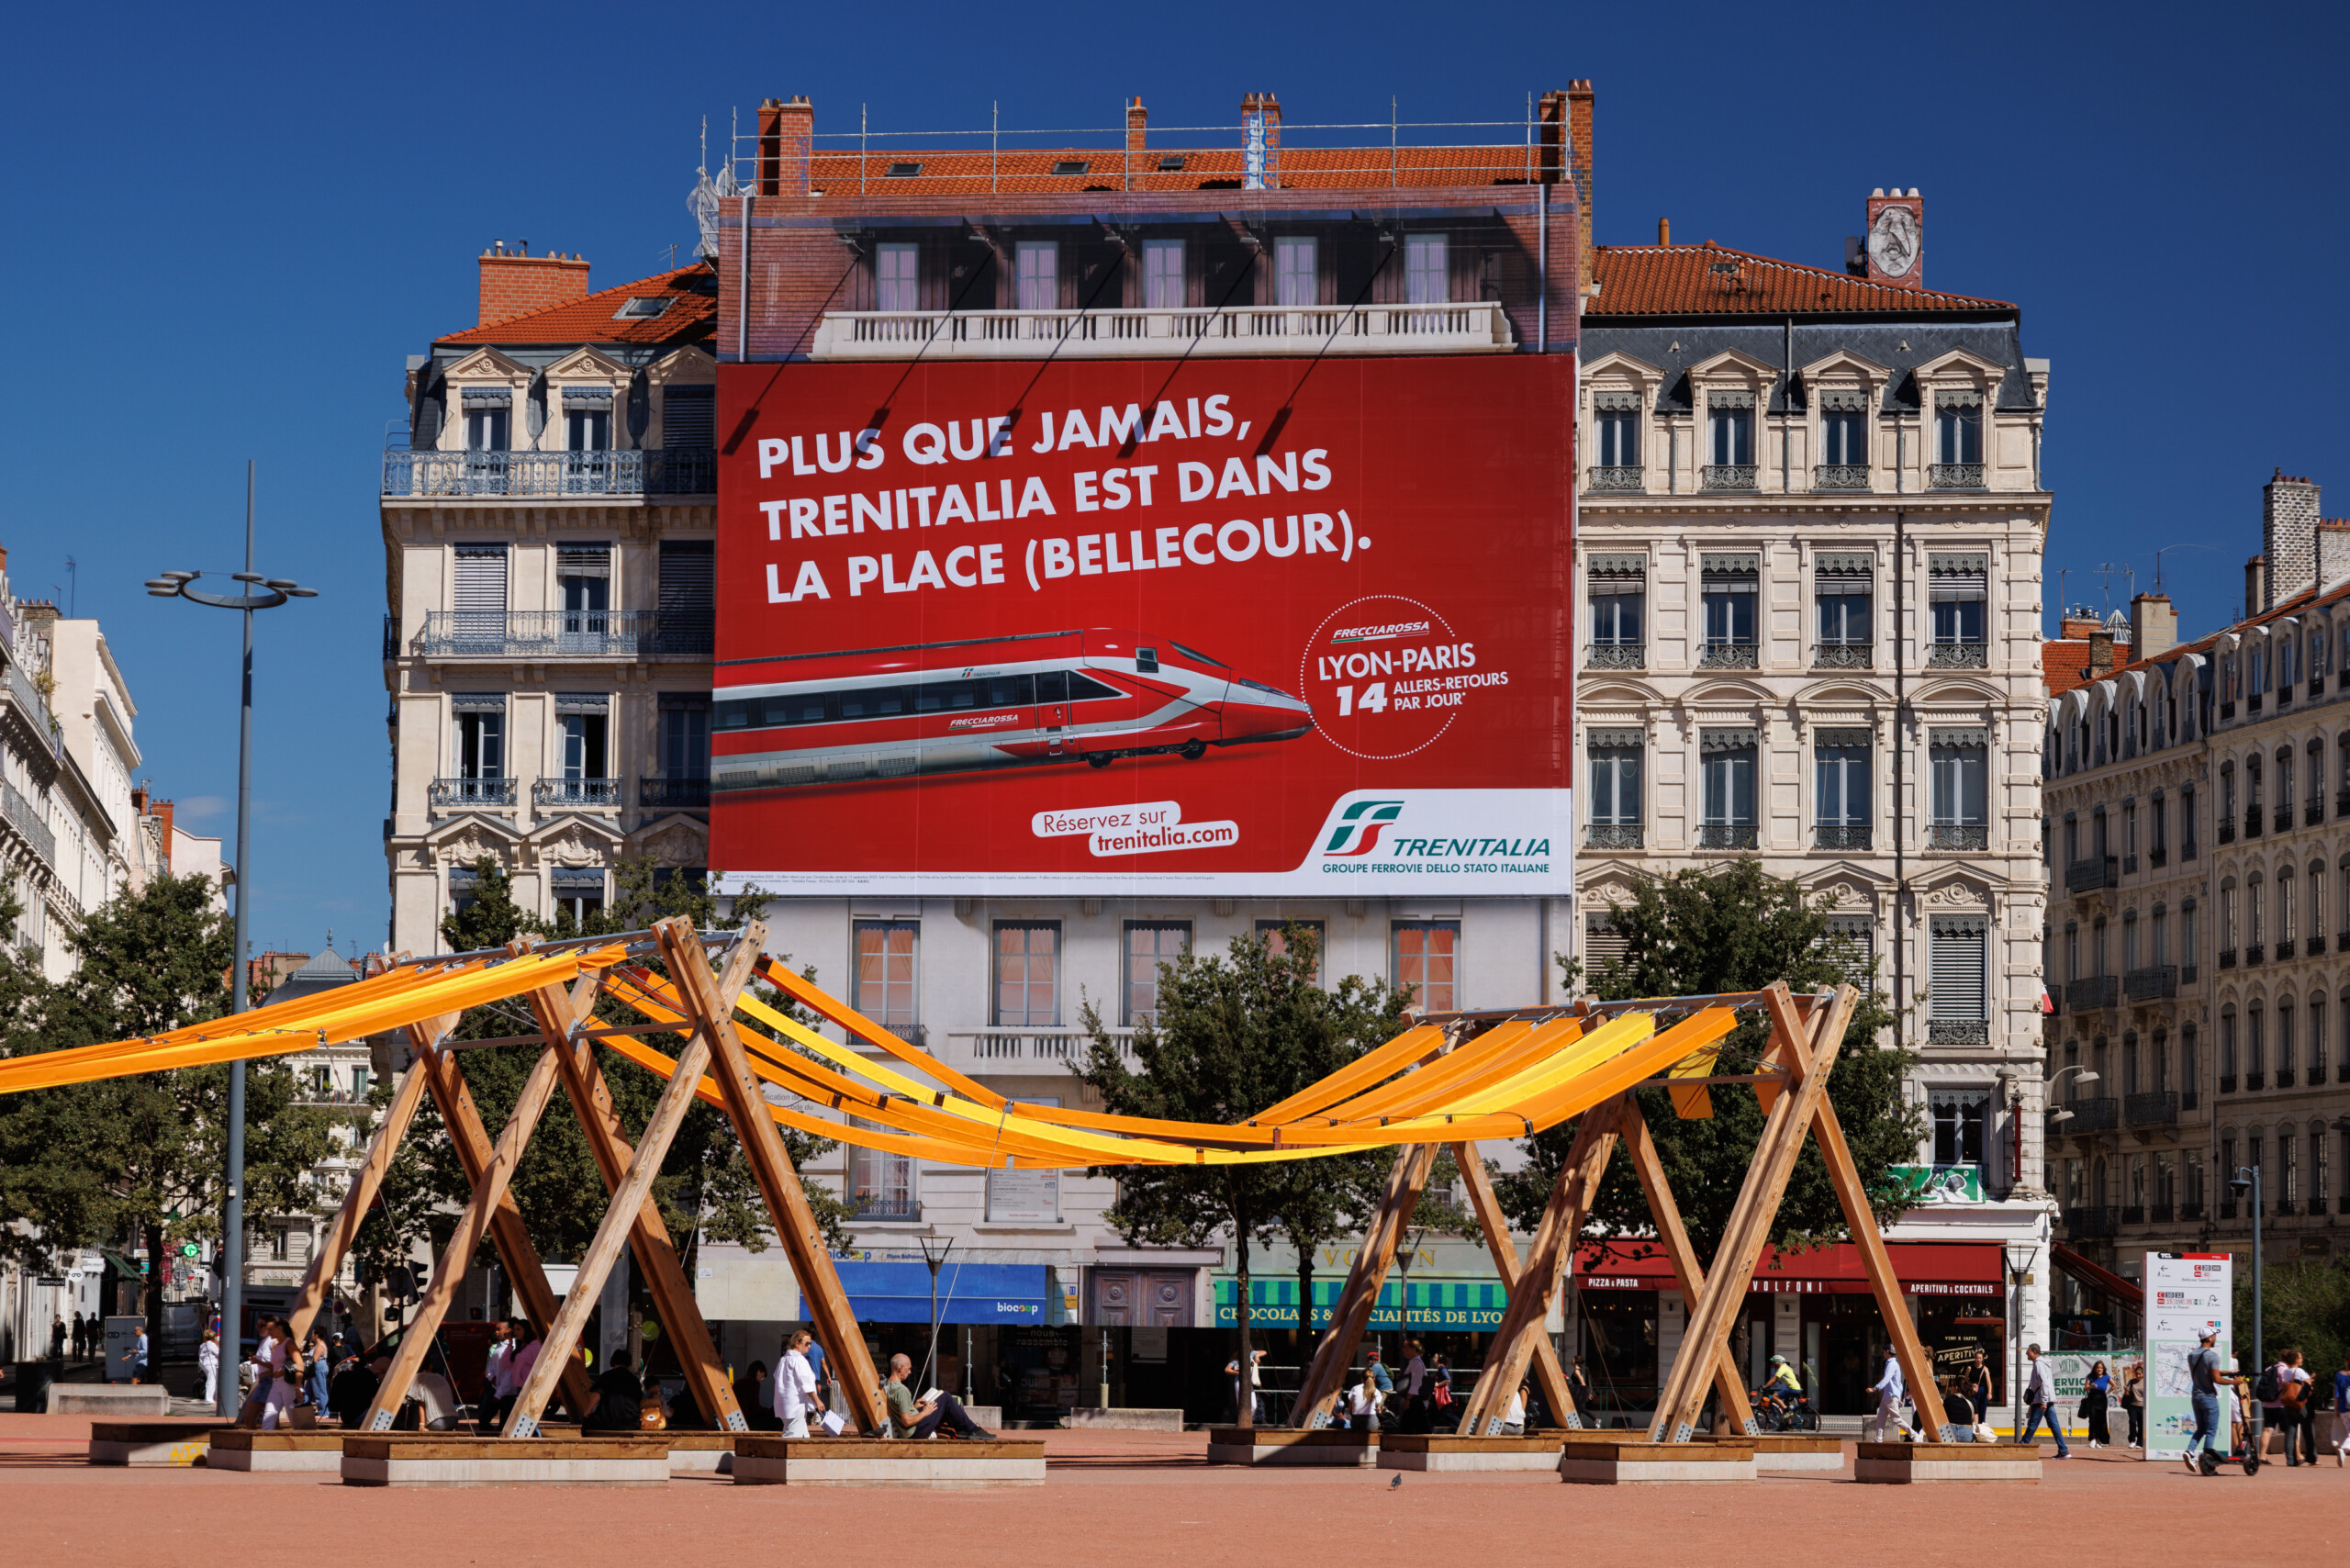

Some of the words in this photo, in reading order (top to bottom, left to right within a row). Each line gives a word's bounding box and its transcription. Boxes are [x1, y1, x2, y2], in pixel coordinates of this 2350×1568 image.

[758, 428, 885, 478] PLUS
[902, 416, 1013, 465] QUE
[1031, 394, 1252, 454] JAMAIS,
[759, 476, 1057, 541] TRENITALIA
[1073, 465, 1158, 512] EST
[1178, 448, 1332, 503] DANS
[766, 560, 831, 604] LA
[847, 543, 1005, 597] PLACE
[1024, 509, 1371, 592] (BELLECOUR).
[1333, 621, 1429, 639] FRECCIAROSSA
[1318, 643, 1476, 681] LYON-PARIS
[1336, 682, 1388, 717] 14
[1393, 671, 1509, 695] ALLERS-RETOURS
[1394, 697, 1421, 711] PAR
[949, 714, 1019, 726] FRECCIAROSSA
[1044, 812, 1132, 833] Réservez
[1139, 810, 1167, 824] sur
[1098, 826, 1233, 852] trenitalia.com
[1393, 838, 1550, 857] TRENITALIA
[1323, 864, 1368, 873] GROUPE
[1371, 864, 1422, 873] FERROVIE
[1427, 864, 1460, 873] DELLO
[1464, 864, 1497, 873] STATO
[1501, 864, 1549, 873] ITALIANE
[1588, 1278, 1609, 1287] PIZZA
[1616, 1279, 1638, 1288] PASTA
[1752, 1281, 1822, 1293] VOLFONI
[1910, 1284, 1948, 1294] APERITIVO
[1954, 1285, 1993, 1294] COCKTAILS
[1445, 1311, 1467, 1323] DE
[1472, 1311, 1505, 1324] LYO
